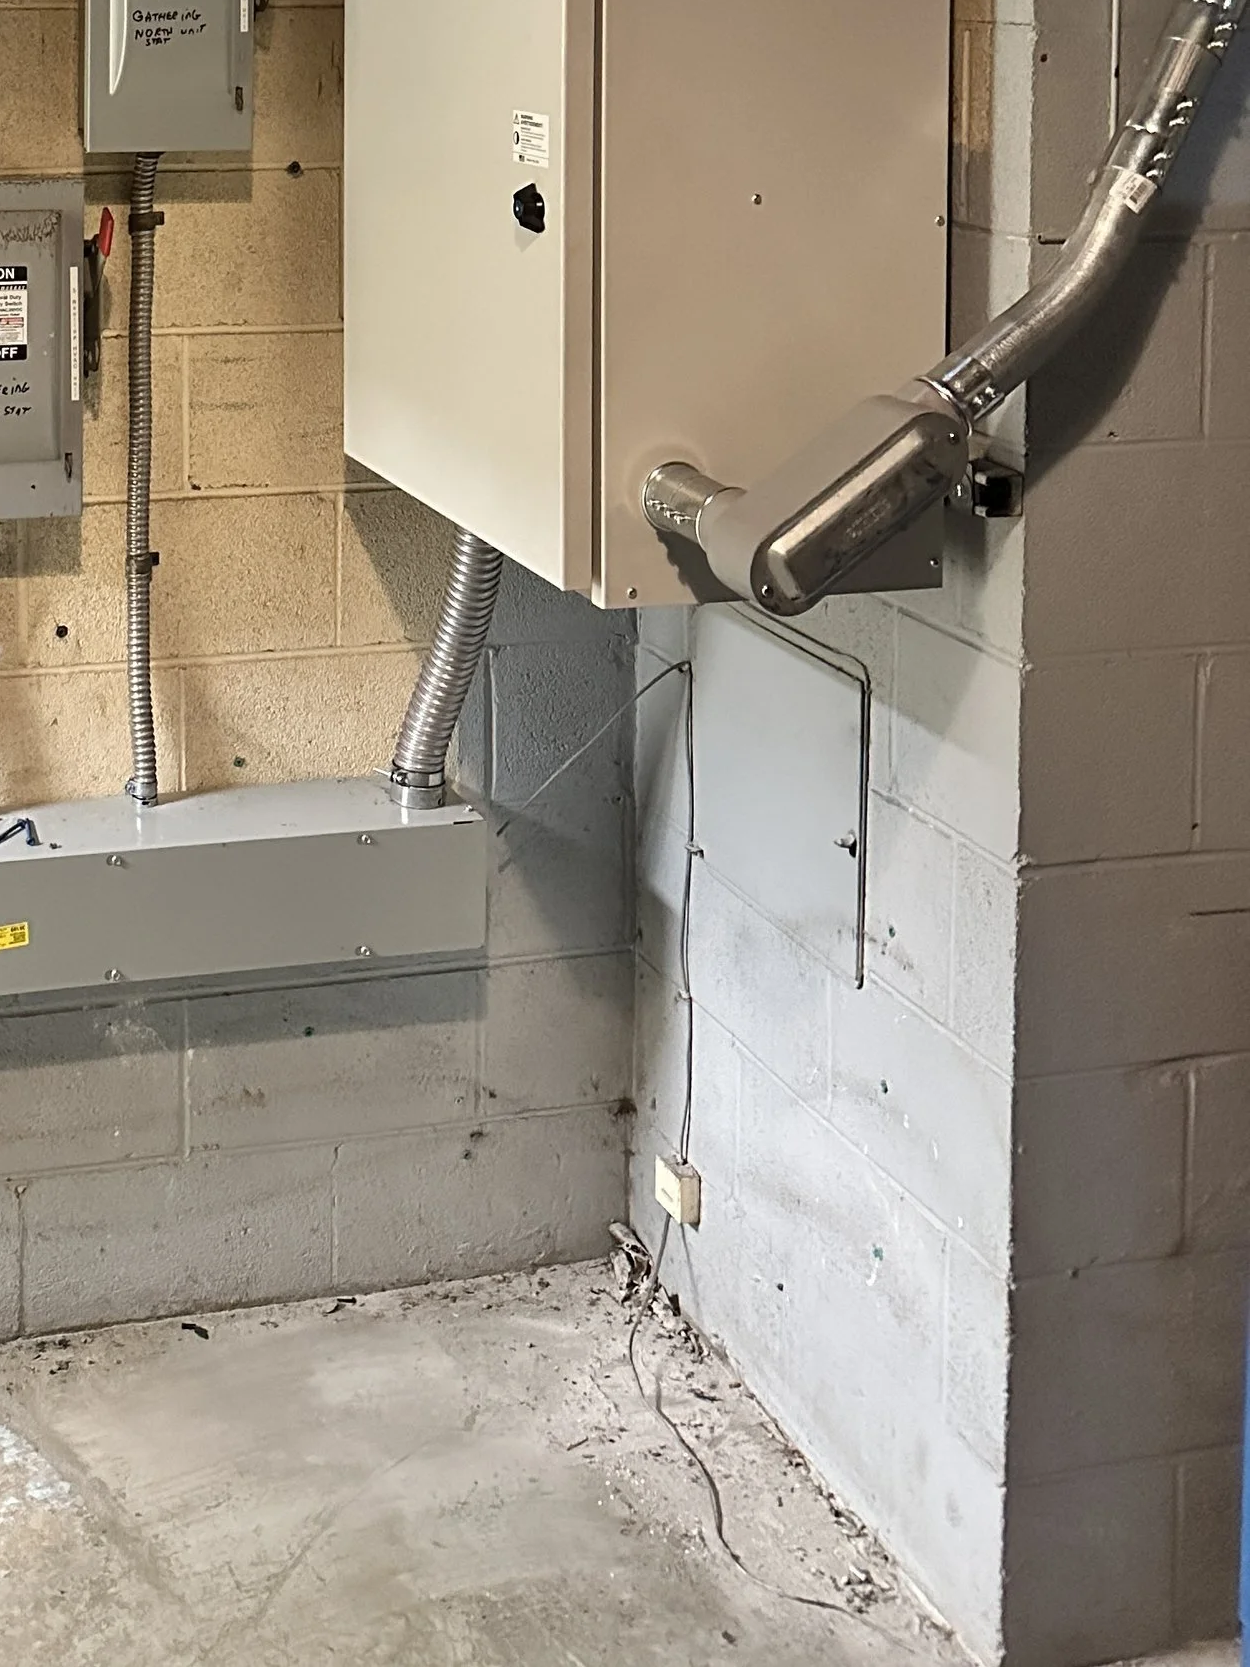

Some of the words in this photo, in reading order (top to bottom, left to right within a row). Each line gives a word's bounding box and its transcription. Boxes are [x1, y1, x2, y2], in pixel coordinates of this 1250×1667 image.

[135, 27, 173, 40] NORTH
[145, 37, 171, 47] STAT
[4, 406, 32, 416] STAT
